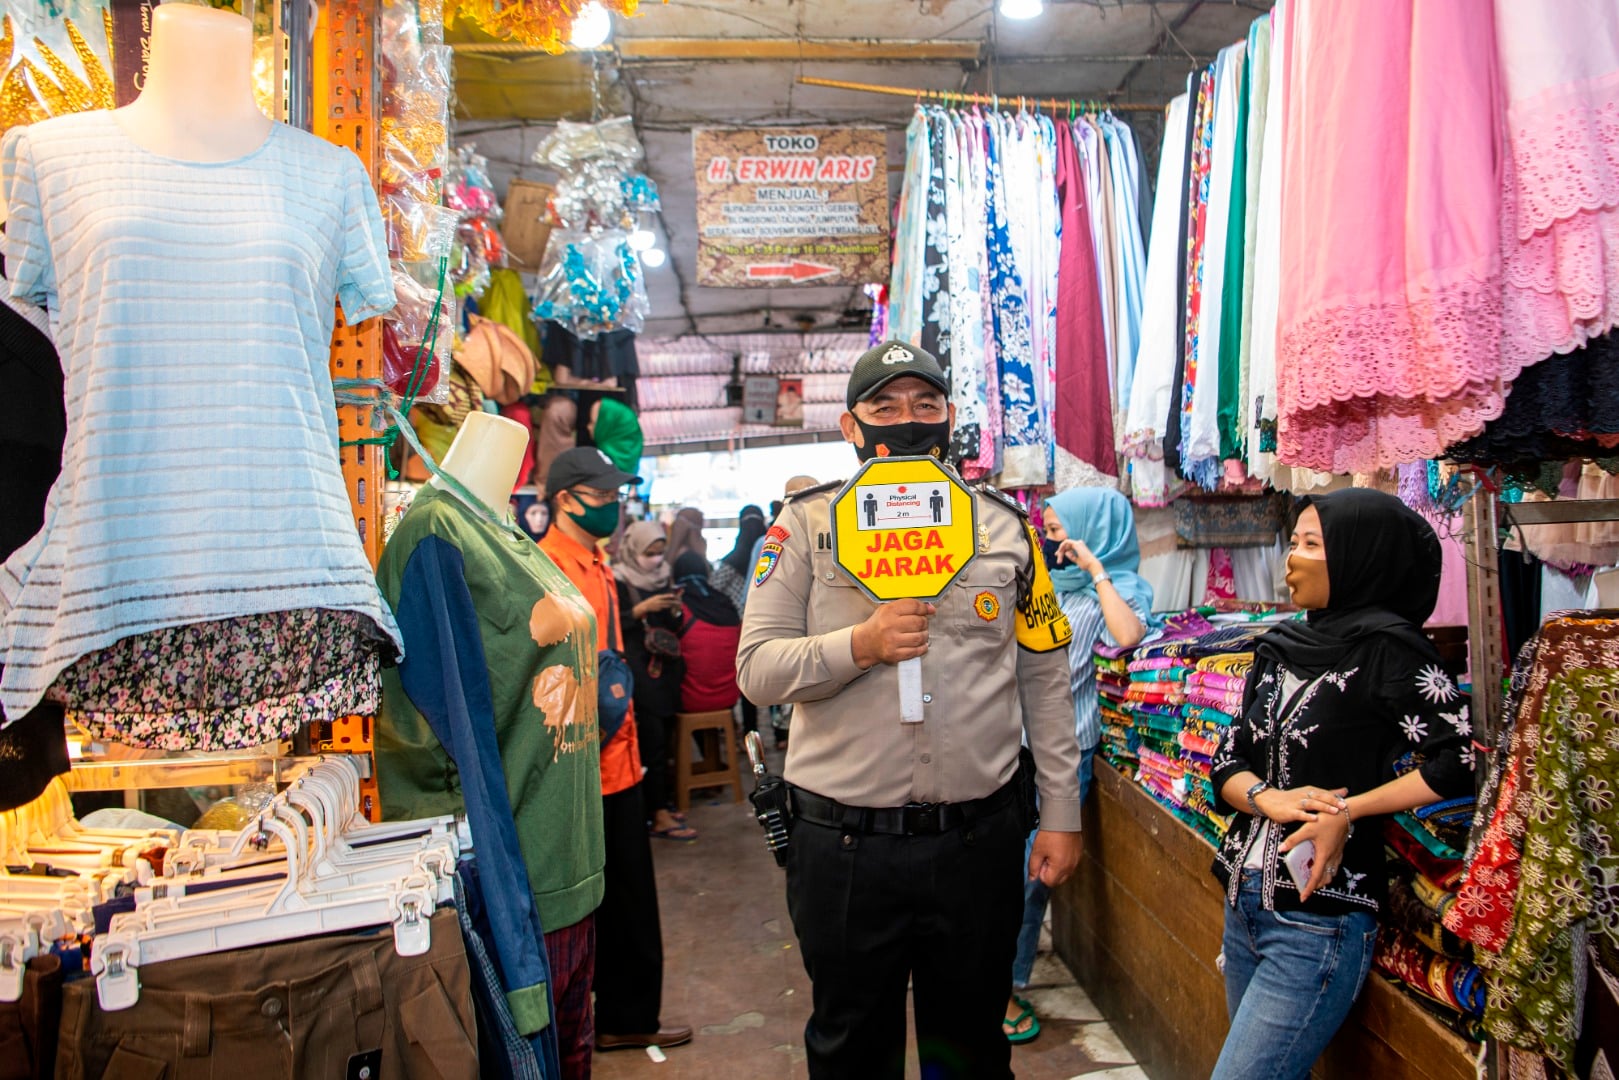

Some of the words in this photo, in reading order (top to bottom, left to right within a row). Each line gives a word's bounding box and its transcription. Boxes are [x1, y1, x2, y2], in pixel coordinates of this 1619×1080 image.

[766, 136, 817, 150] TOKO
[709, 160, 731, 180] H.
[738, 159, 816, 180] ERWIN
[820, 158, 875, 180] ARIS
[757, 189, 820, 201] MENJUAL
[829, 244, 880, 256] Palembang
[886, 499, 921, 508] Distancing
[866, 530, 944, 553] JAGA
[858, 554, 955, 579] JARAK
